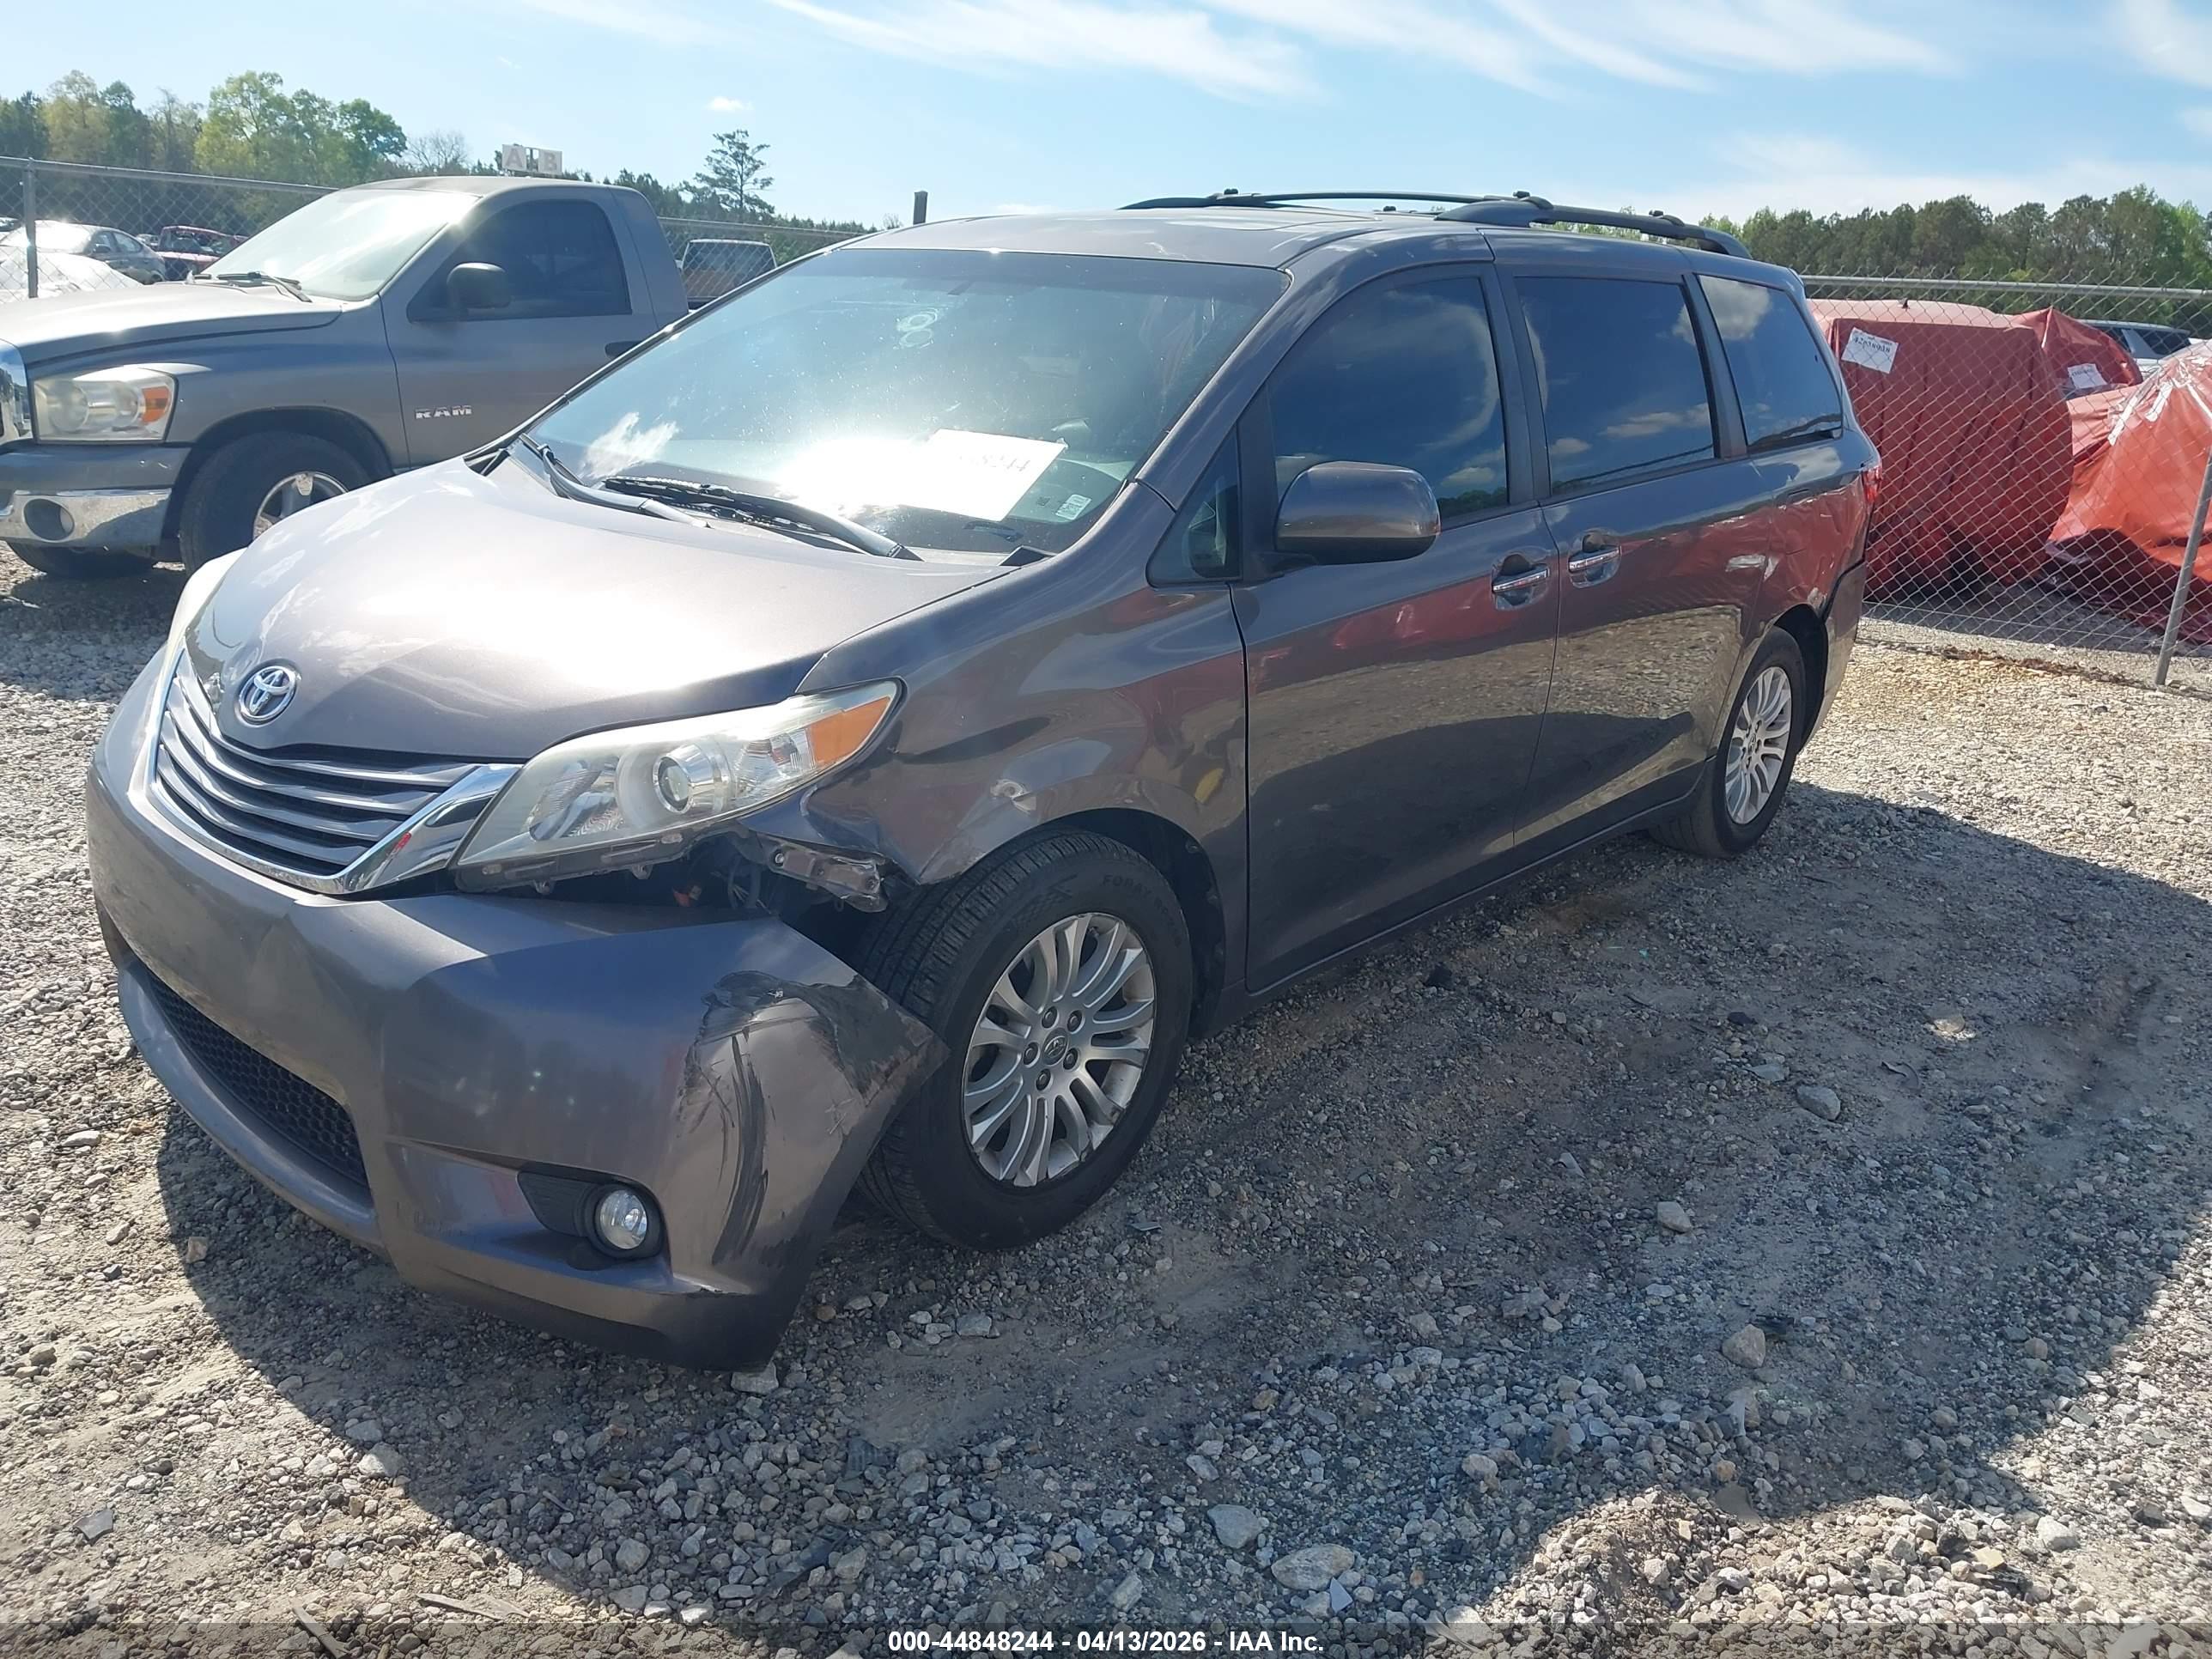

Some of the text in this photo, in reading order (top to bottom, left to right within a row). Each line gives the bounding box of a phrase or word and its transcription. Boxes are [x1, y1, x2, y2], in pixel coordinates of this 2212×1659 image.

[505, 148, 557, 171] A B
[415, 404, 472, 419] RAM
